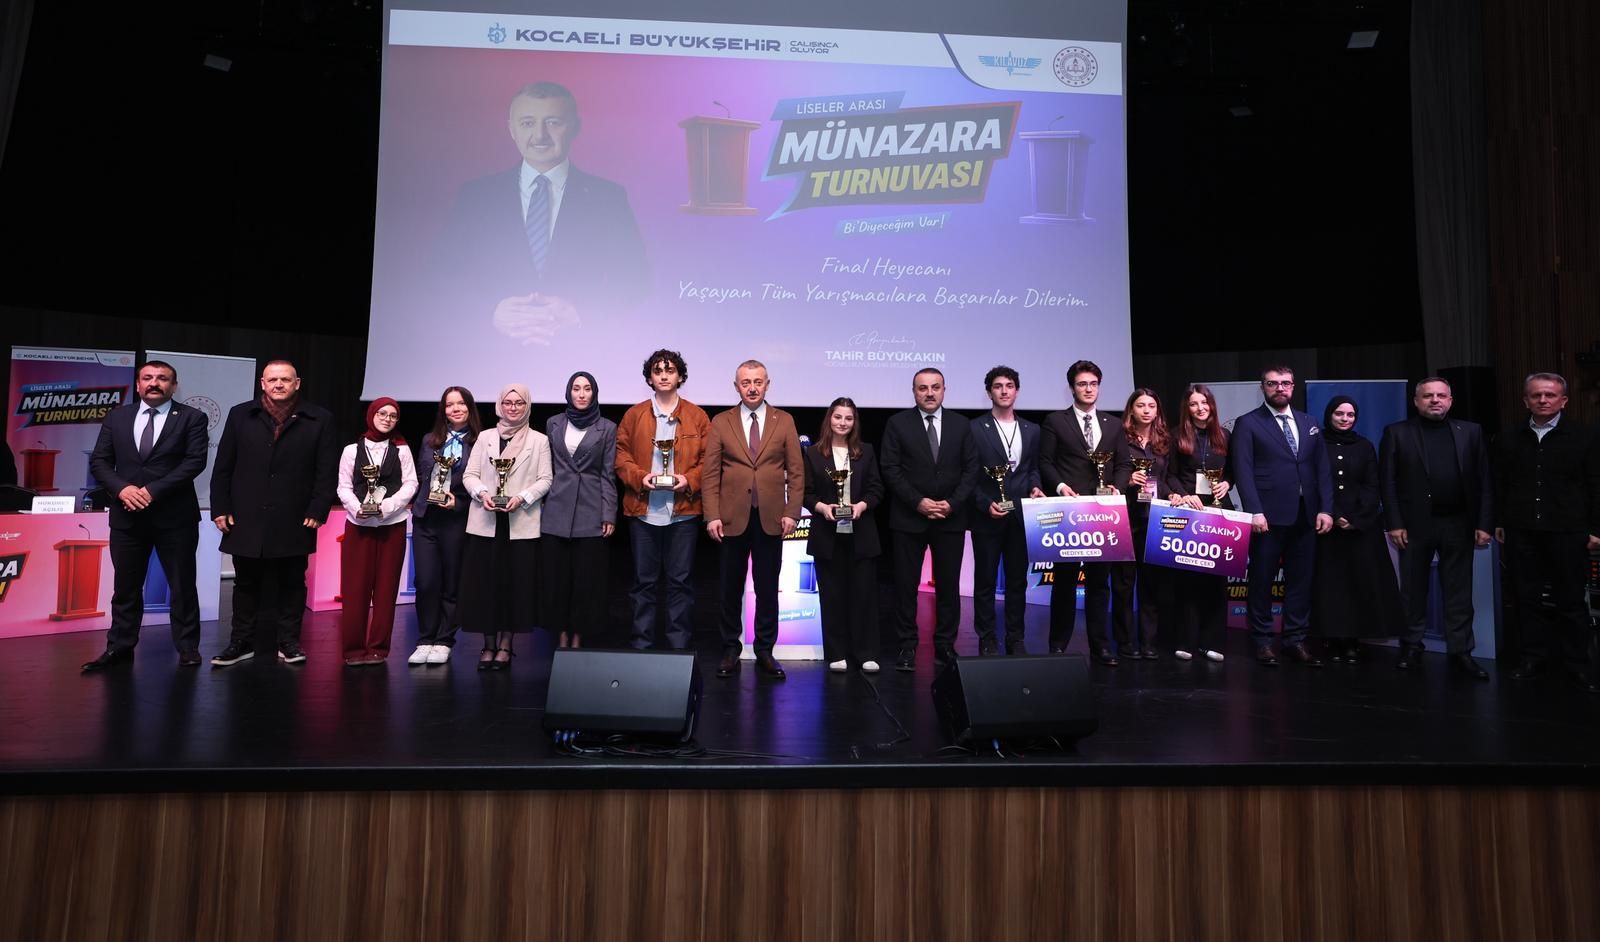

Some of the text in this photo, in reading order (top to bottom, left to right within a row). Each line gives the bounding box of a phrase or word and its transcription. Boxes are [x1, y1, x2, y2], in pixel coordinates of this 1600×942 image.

[796, 99, 886, 114] LİSELER ARASI
[778, 118, 1001, 165] MÜNAZARA
[810, 160, 983, 198] TURNUVASI
[821, 256, 951, 280] Final Heyecanı
[678, 280, 1089, 308] Yaşayan Tüm Yarışmacılara Başarılar Dilerim.
[824, 350, 945, 362] TAHİR BÜYÜKAKIN
[22, 391, 120, 410] MÜNAZARA
[1041, 531, 1105, 547] 60.000
[1160, 536, 1221, 559] 50.000
